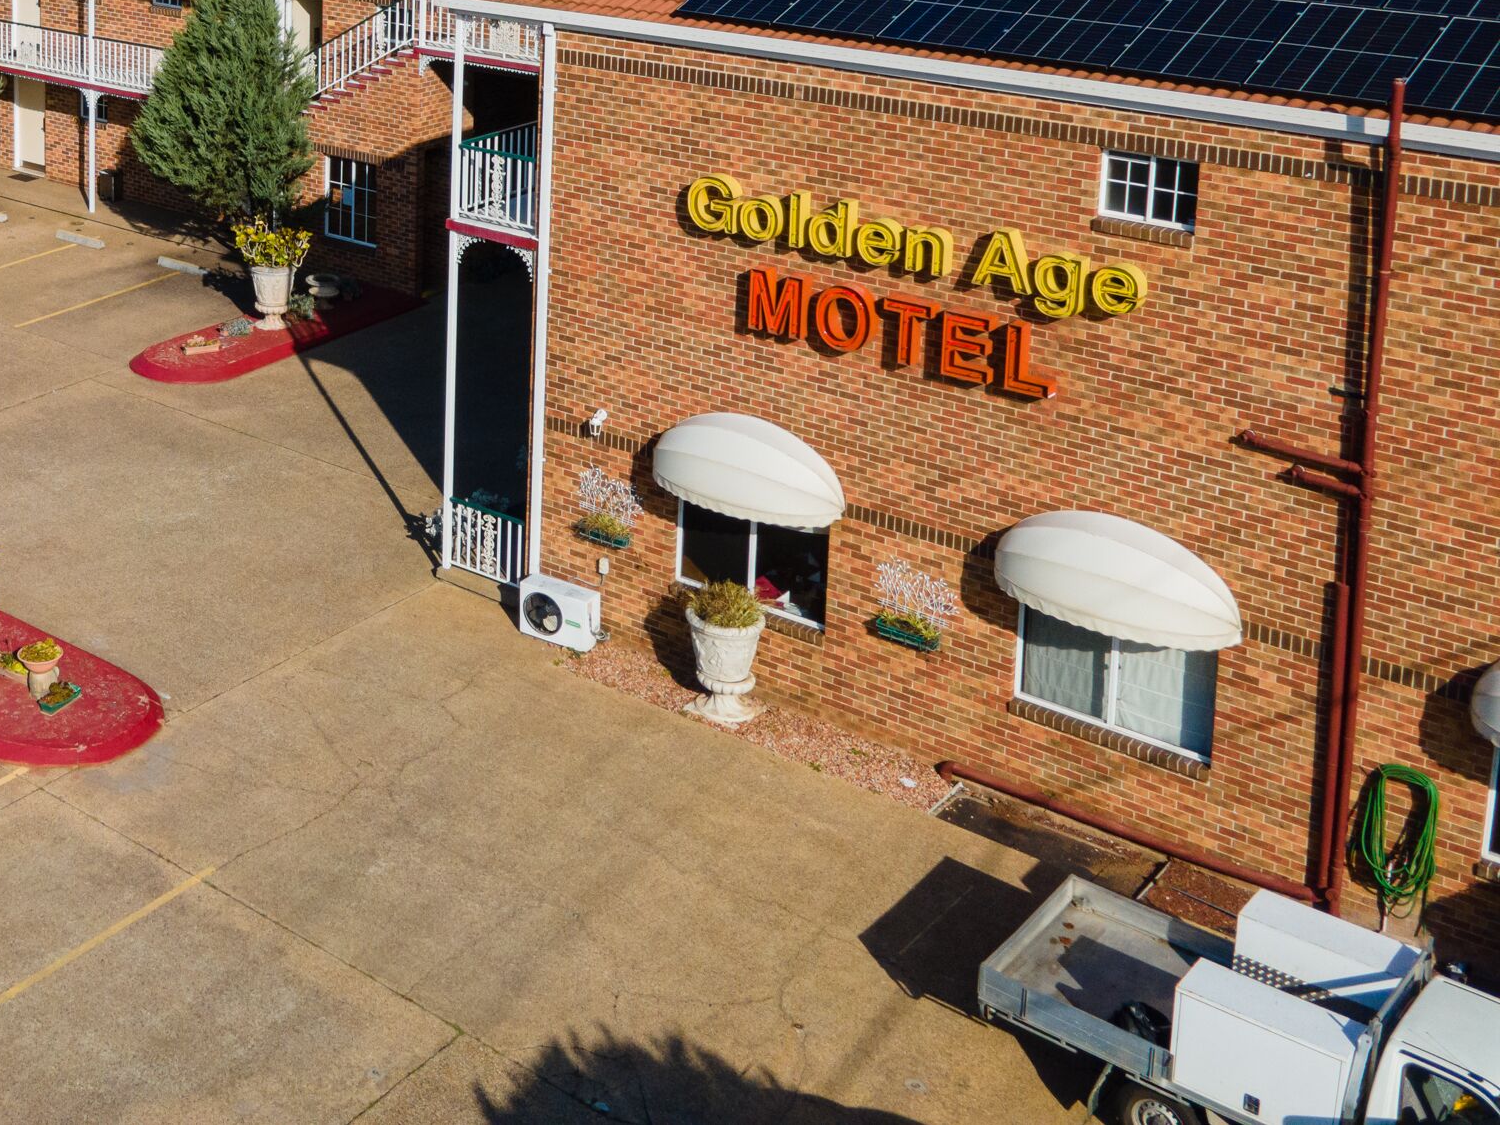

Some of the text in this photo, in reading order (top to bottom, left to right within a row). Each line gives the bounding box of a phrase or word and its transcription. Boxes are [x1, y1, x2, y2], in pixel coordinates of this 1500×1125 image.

[687, 172, 1149, 318] Golden Age
[747, 265, 1057, 400] MOTEL
